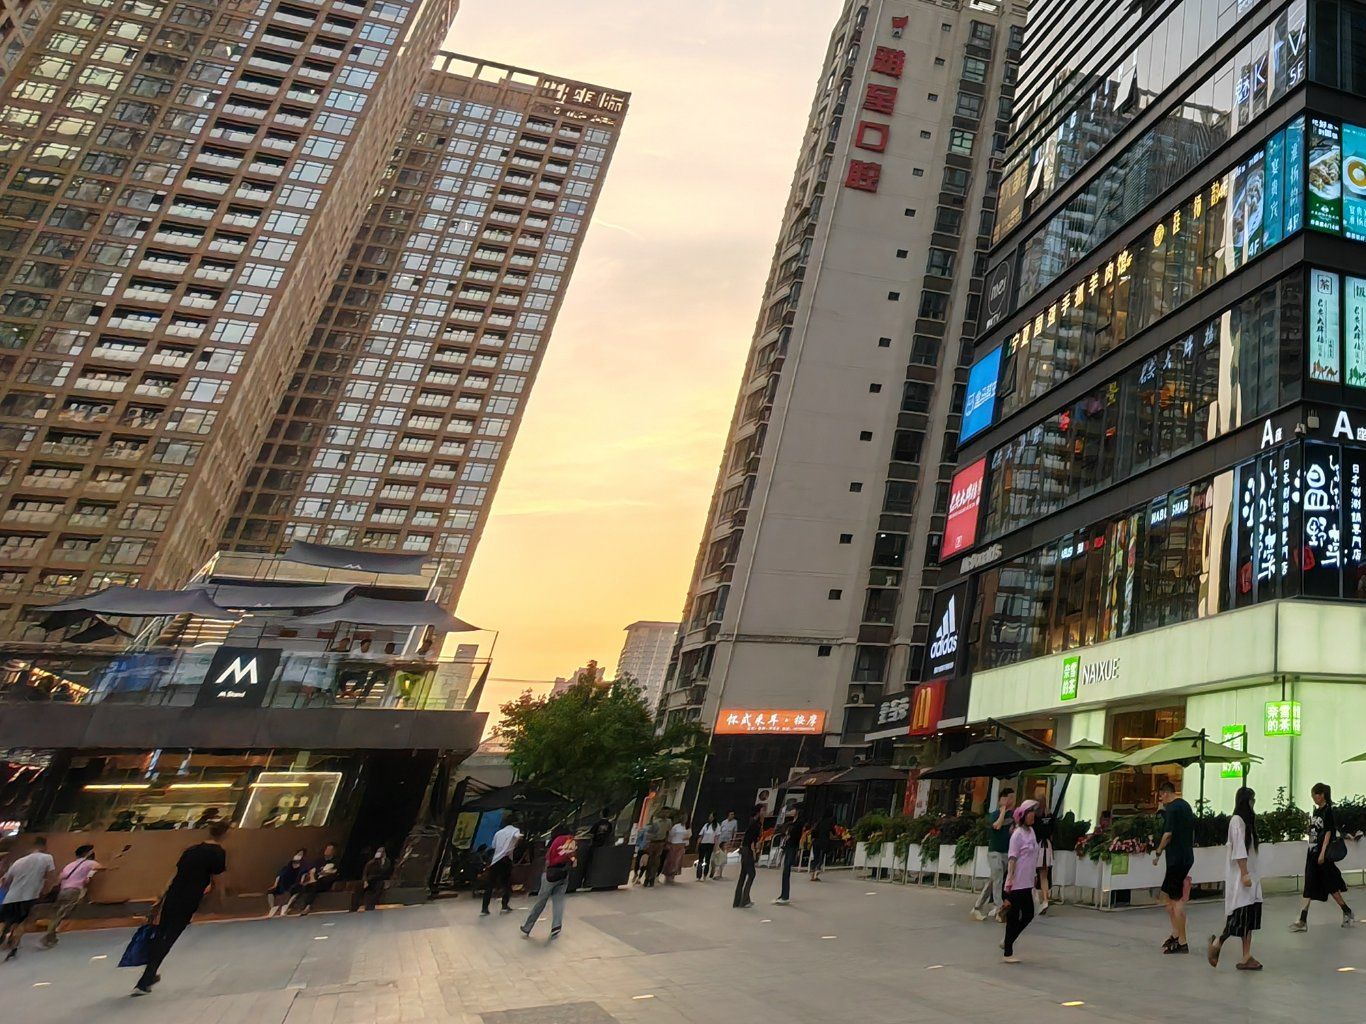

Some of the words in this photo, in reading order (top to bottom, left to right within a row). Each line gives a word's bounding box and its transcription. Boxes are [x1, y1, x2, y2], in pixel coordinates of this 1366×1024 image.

[1261, 418, 1283, 449] A座
[930, 634, 958, 660] adidas
[1081, 658, 1121, 686] NAIXUE
